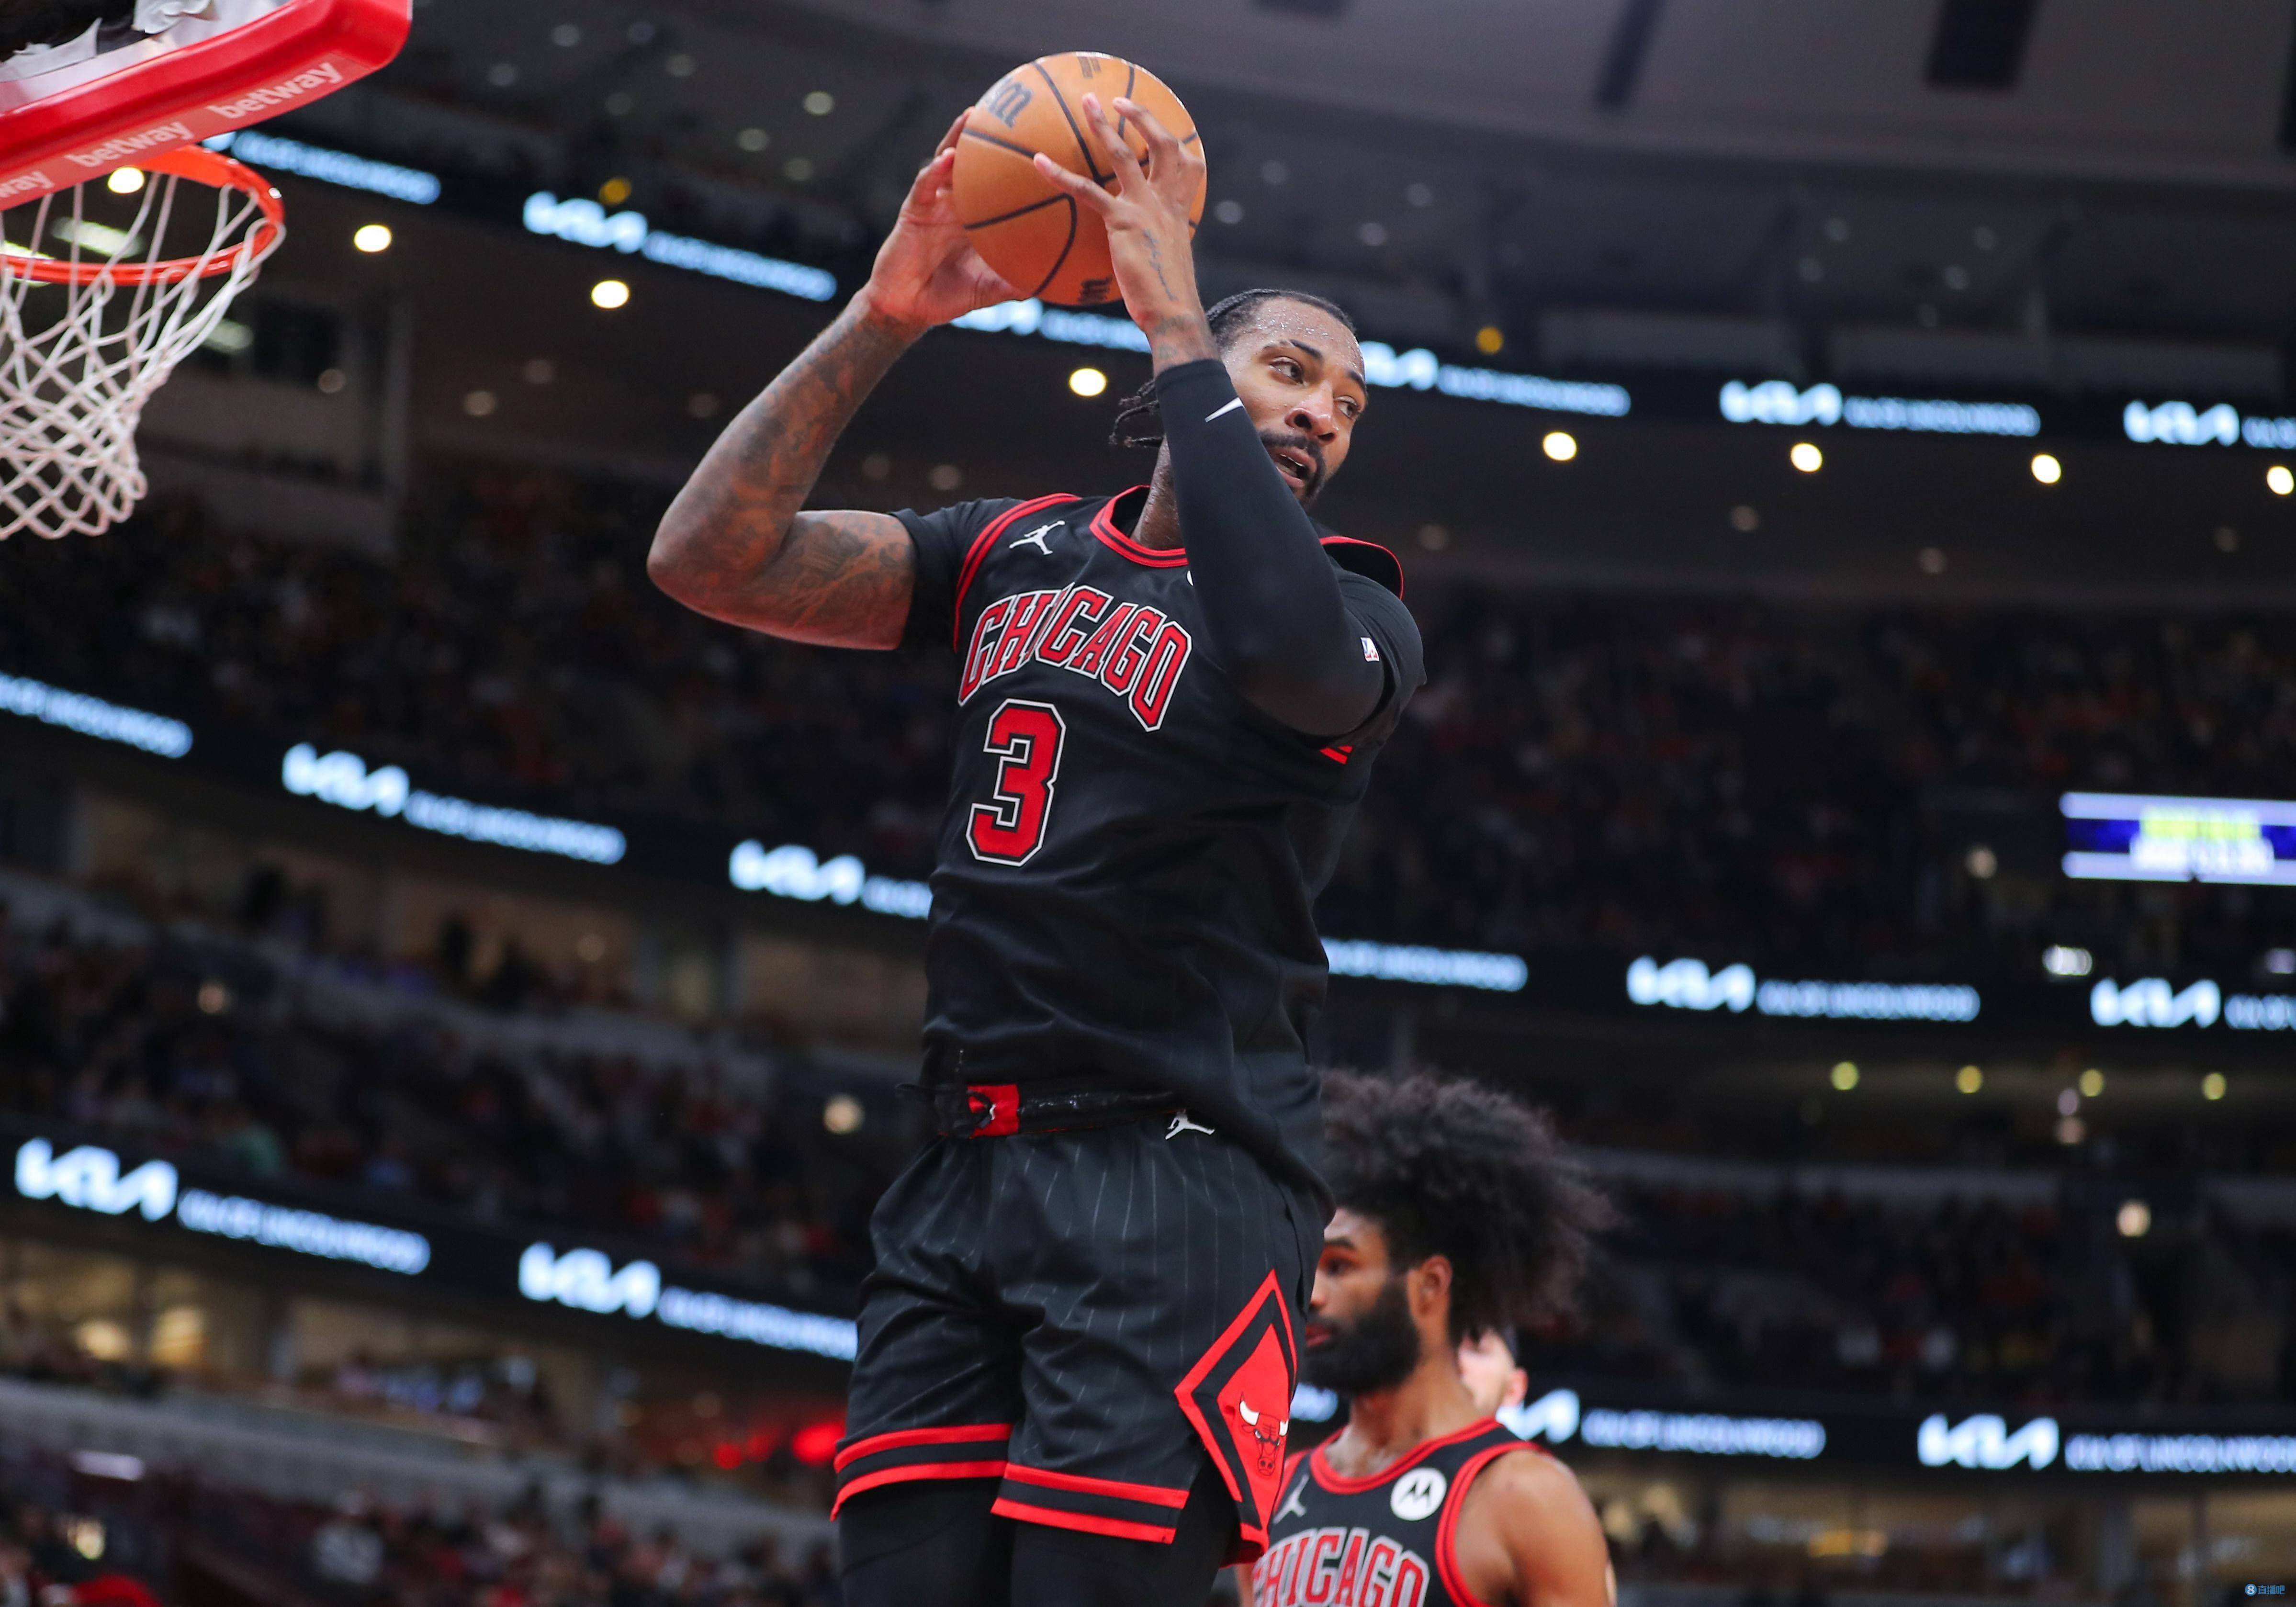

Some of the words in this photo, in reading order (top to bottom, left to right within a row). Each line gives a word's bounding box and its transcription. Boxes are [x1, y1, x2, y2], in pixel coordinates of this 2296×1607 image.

[206, 62, 343, 119] betway
[64, 122, 195, 168] betway
[959, 582, 1192, 731] CHICAGO
[966, 697, 1066, 866] 3
